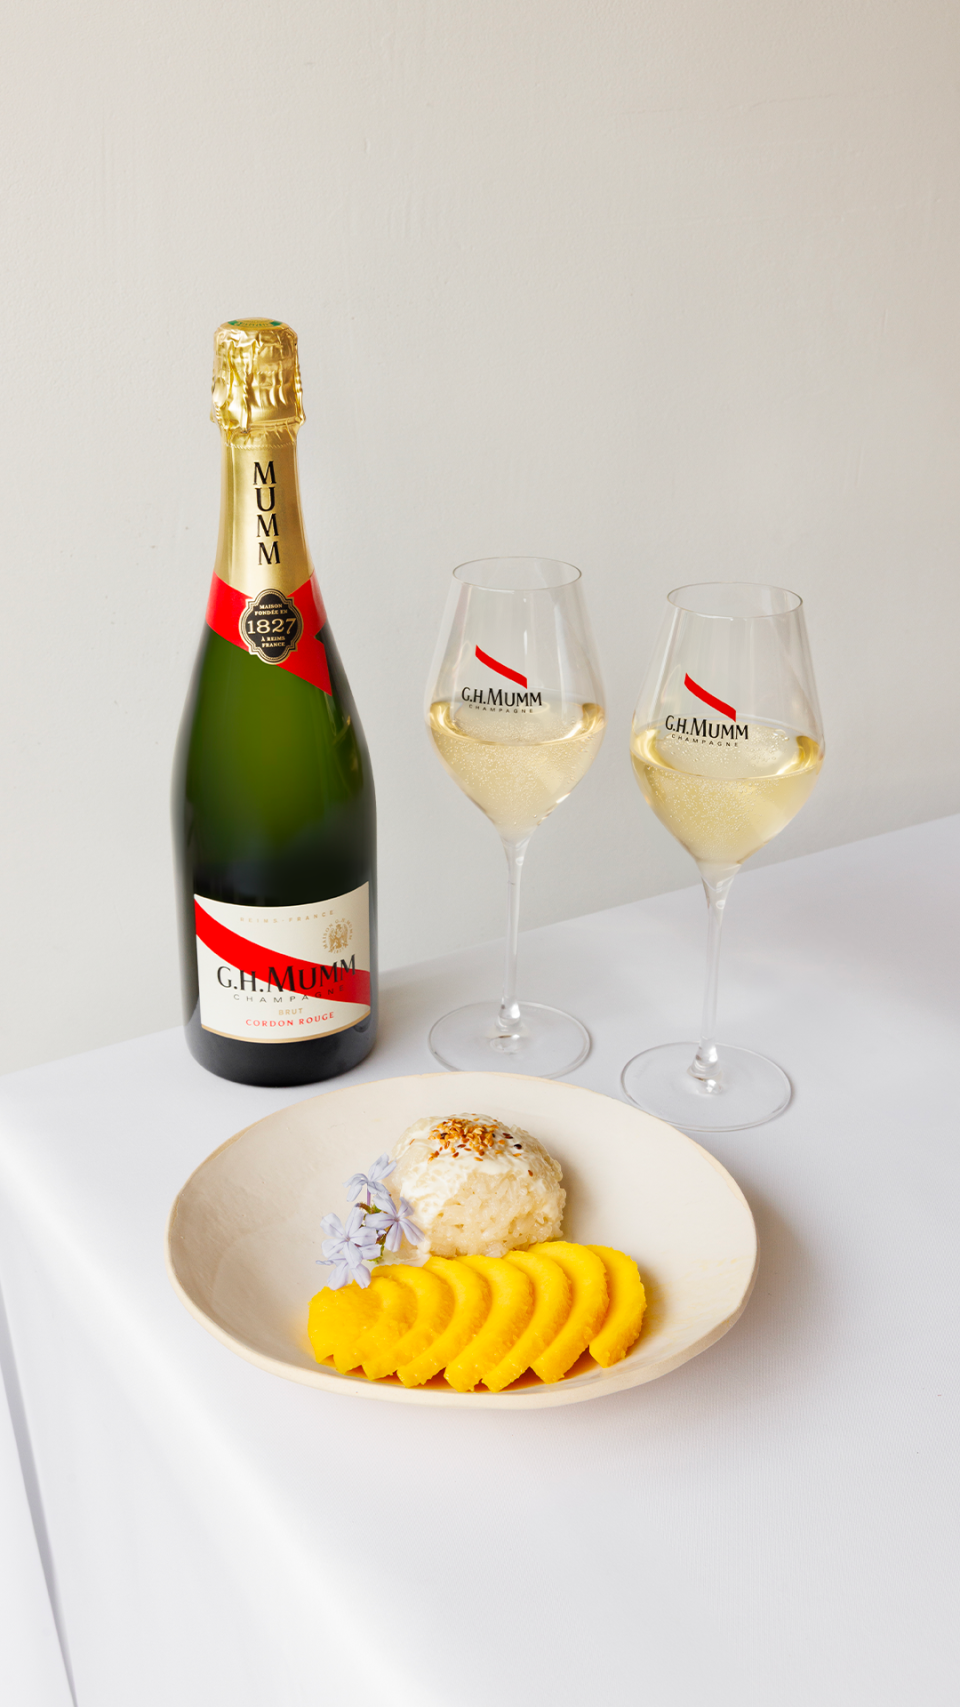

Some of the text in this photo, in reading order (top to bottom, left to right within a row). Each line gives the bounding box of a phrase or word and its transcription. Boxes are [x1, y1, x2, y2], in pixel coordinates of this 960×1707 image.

[253, 460, 281, 566] MUMM
[254, 608, 279, 616] FONDÉE
[247, 617, 297, 635] 1827
[468, 704, 534, 714] CHAMPAGNE
[671, 733, 739, 747] CHAMPAGNE
[233, 984, 345, 1003] CHAMPAGNE
[245, 1011, 335, 1027] CORDON ROUGE
[278, 1007, 303, 1016] BRUT
